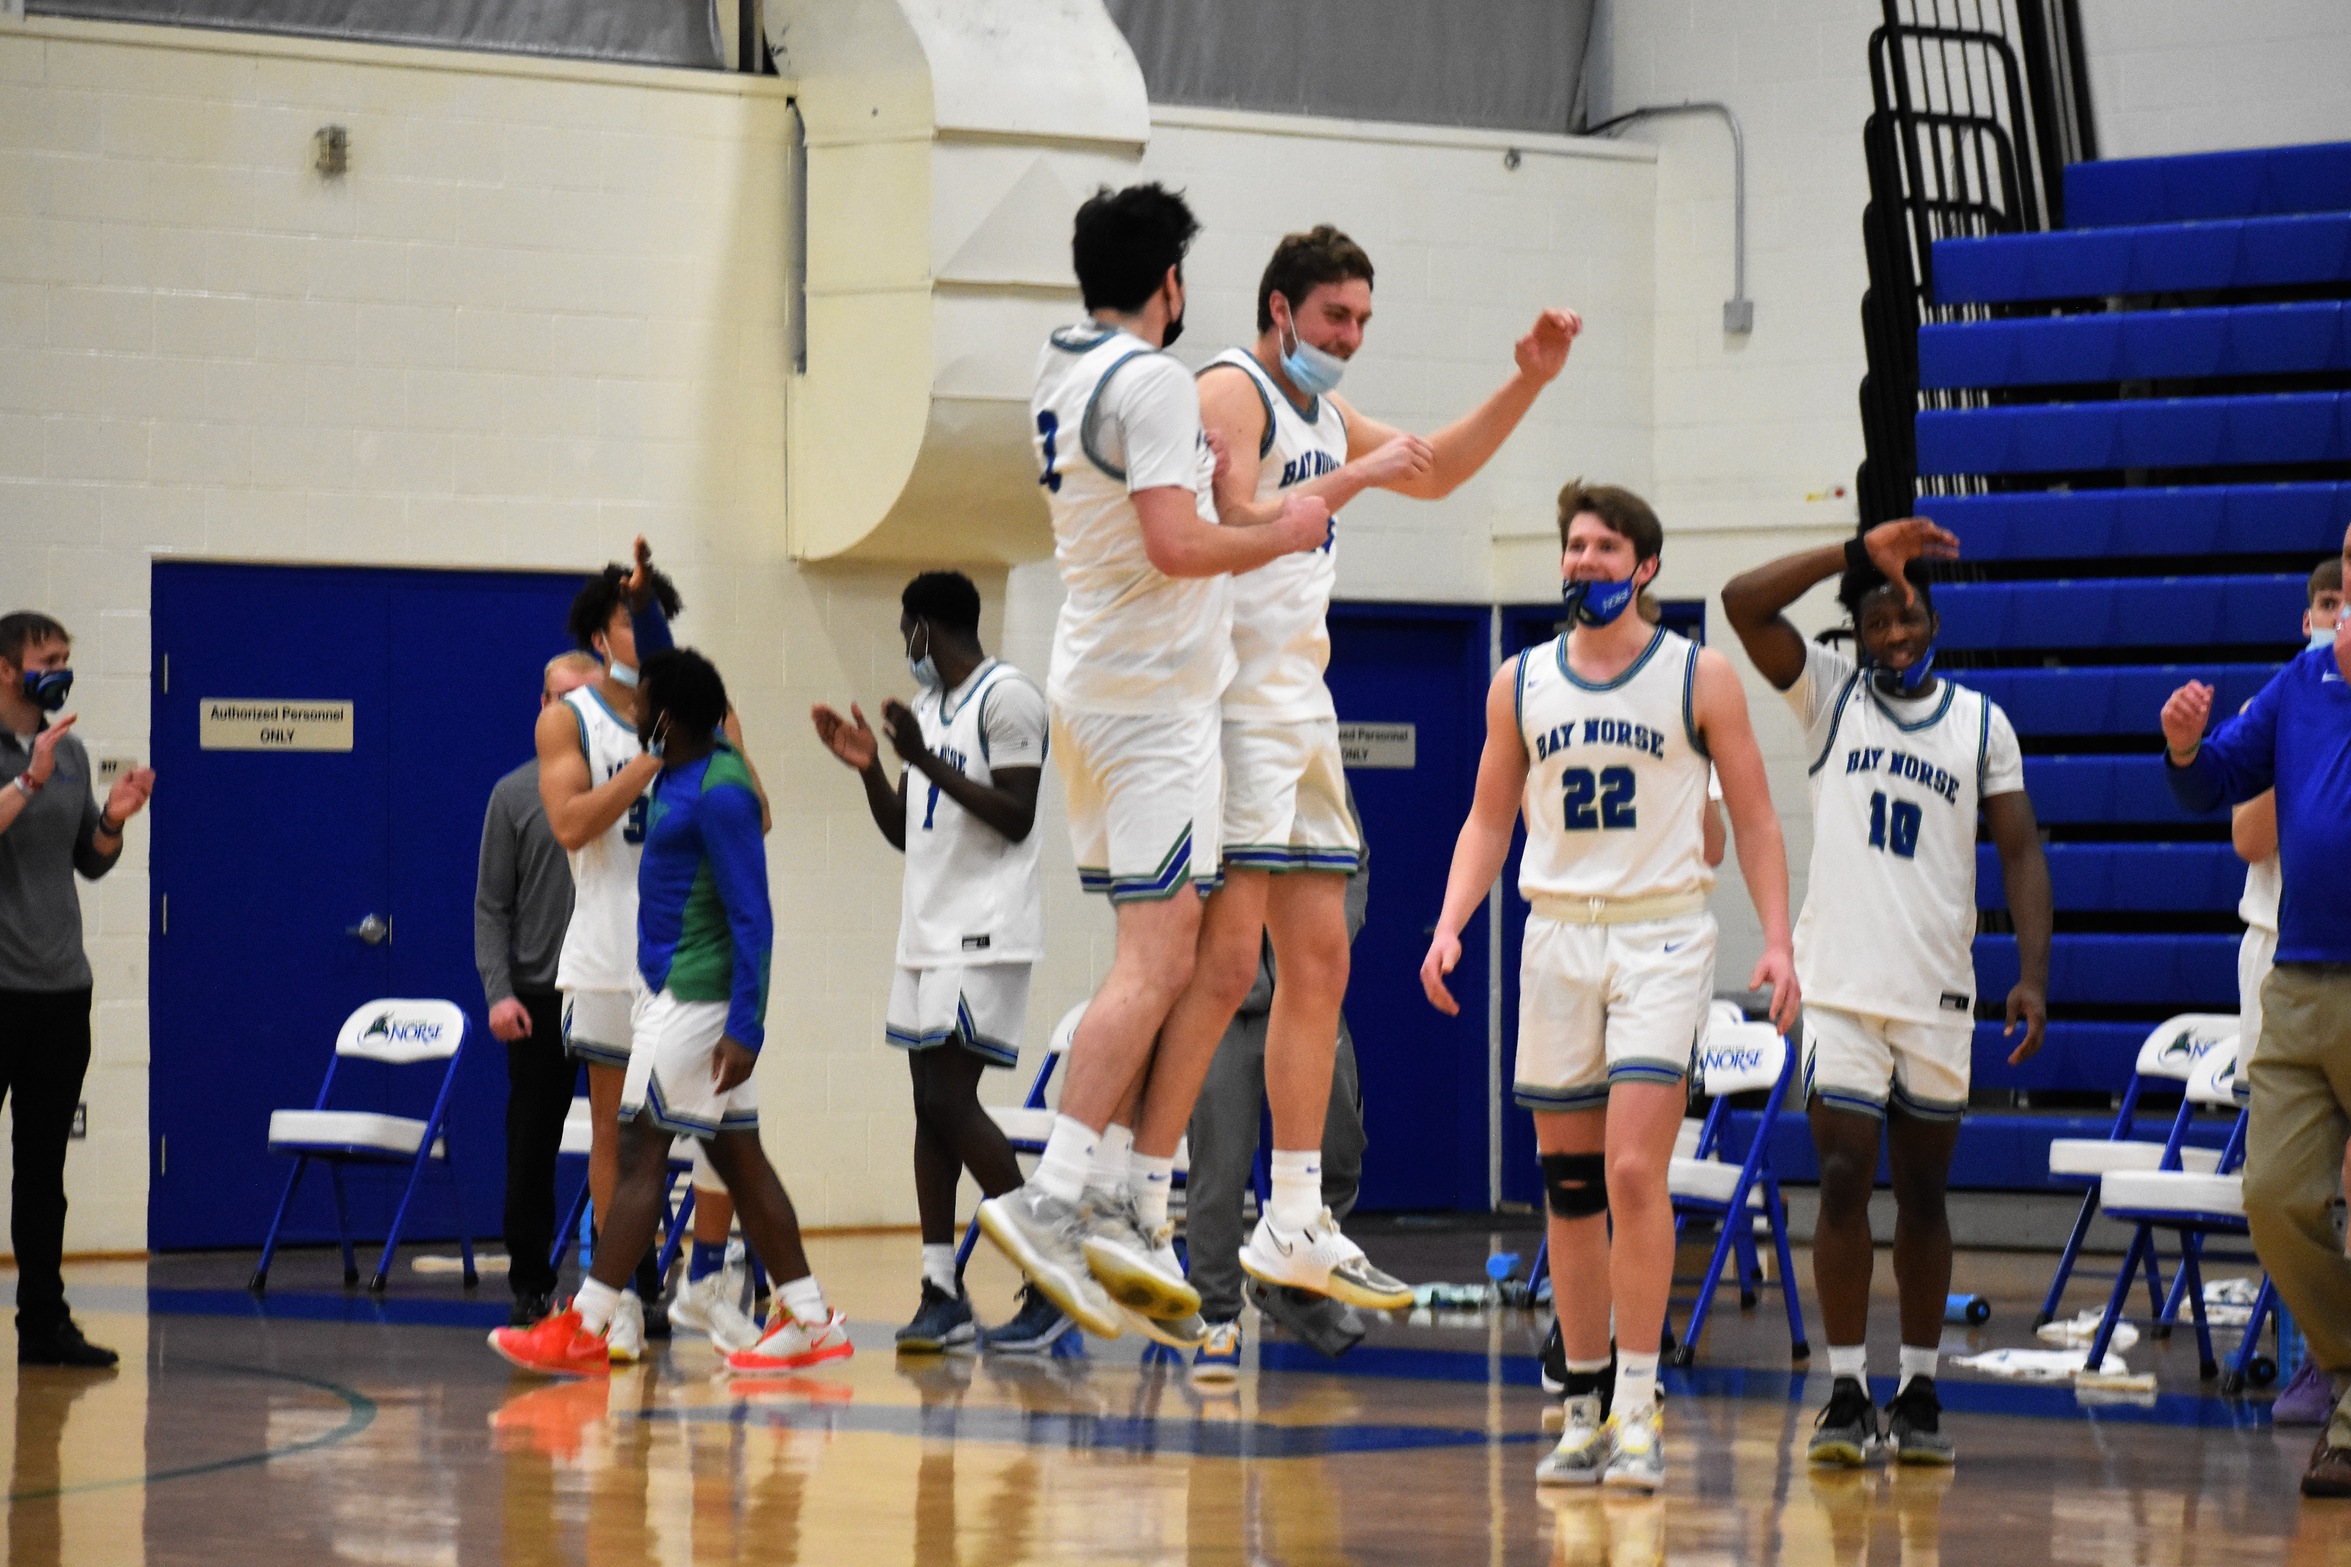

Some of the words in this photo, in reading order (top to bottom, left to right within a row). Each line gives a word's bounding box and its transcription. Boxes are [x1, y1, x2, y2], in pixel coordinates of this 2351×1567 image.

[1278, 450, 1311, 489] BAY
[211, 704, 278, 722] Authorized
[282, 705, 344, 723] Personnel
[260, 727, 295, 744] ONLY
[1537, 720, 1576, 761] BAY
[1583, 717, 1664, 760] NORSE
[1846, 746, 1885, 775] BAY
[1888, 749, 1959, 806] NORSE
[1561, 764, 1637, 831] 22
[1868, 788, 1922, 860] 10
[388, 1022, 443, 1046] NORSE
[1703, 1048, 1762, 1075] NORSE
